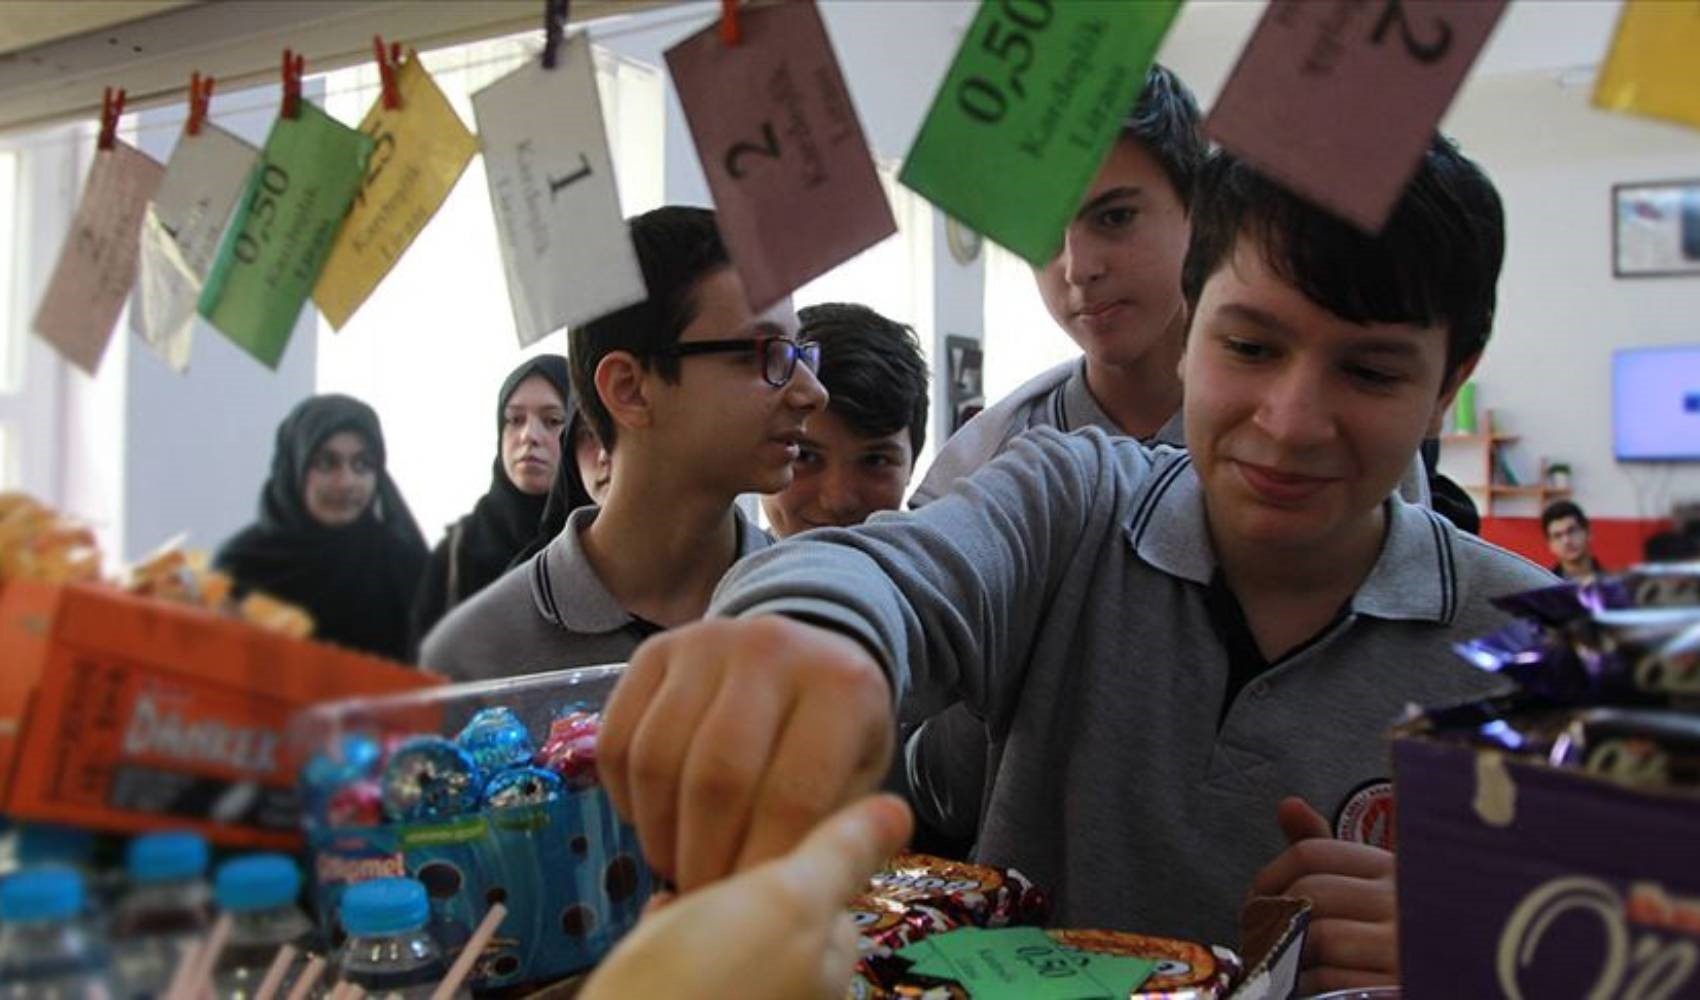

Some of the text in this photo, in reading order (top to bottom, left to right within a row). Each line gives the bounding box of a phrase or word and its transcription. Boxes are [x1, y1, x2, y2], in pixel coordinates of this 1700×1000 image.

[957, 0, 1055, 124] 0,50
[1369, 0, 1453, 62] 2
[547, 152, 593, 203] 1
[725, 121, 781, 180] 2
[233, 164, 289, 264] 0,50
